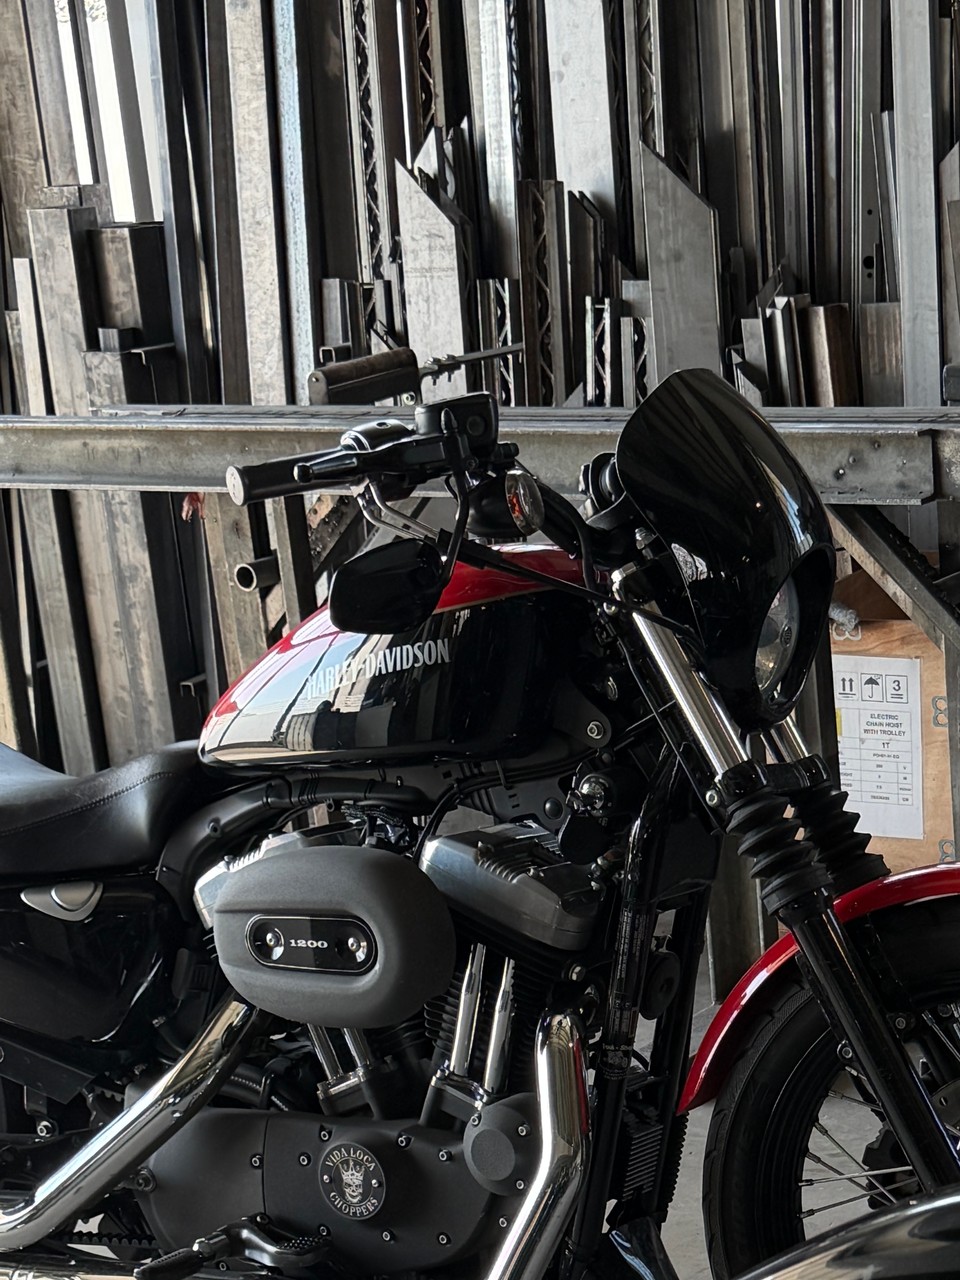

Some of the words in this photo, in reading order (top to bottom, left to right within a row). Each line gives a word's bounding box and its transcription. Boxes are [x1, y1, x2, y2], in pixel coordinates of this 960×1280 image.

[305, 638, 451, 700] HARLEY-DAVIDSON
[869, 713, 899, 721] ELECTRIC
[866, 720, 885, 728] CHAIN
[885, 721, 903, 729] HOIST
[879, 729, 906, 737] TROLLEY
[289, 939, 329, 949] 1200
[325, 1147, 348, 1167] VIDA
[350, 1147, 376, 1171] LOCA
[329, 1192, 379, 1217] CHOPPERS
